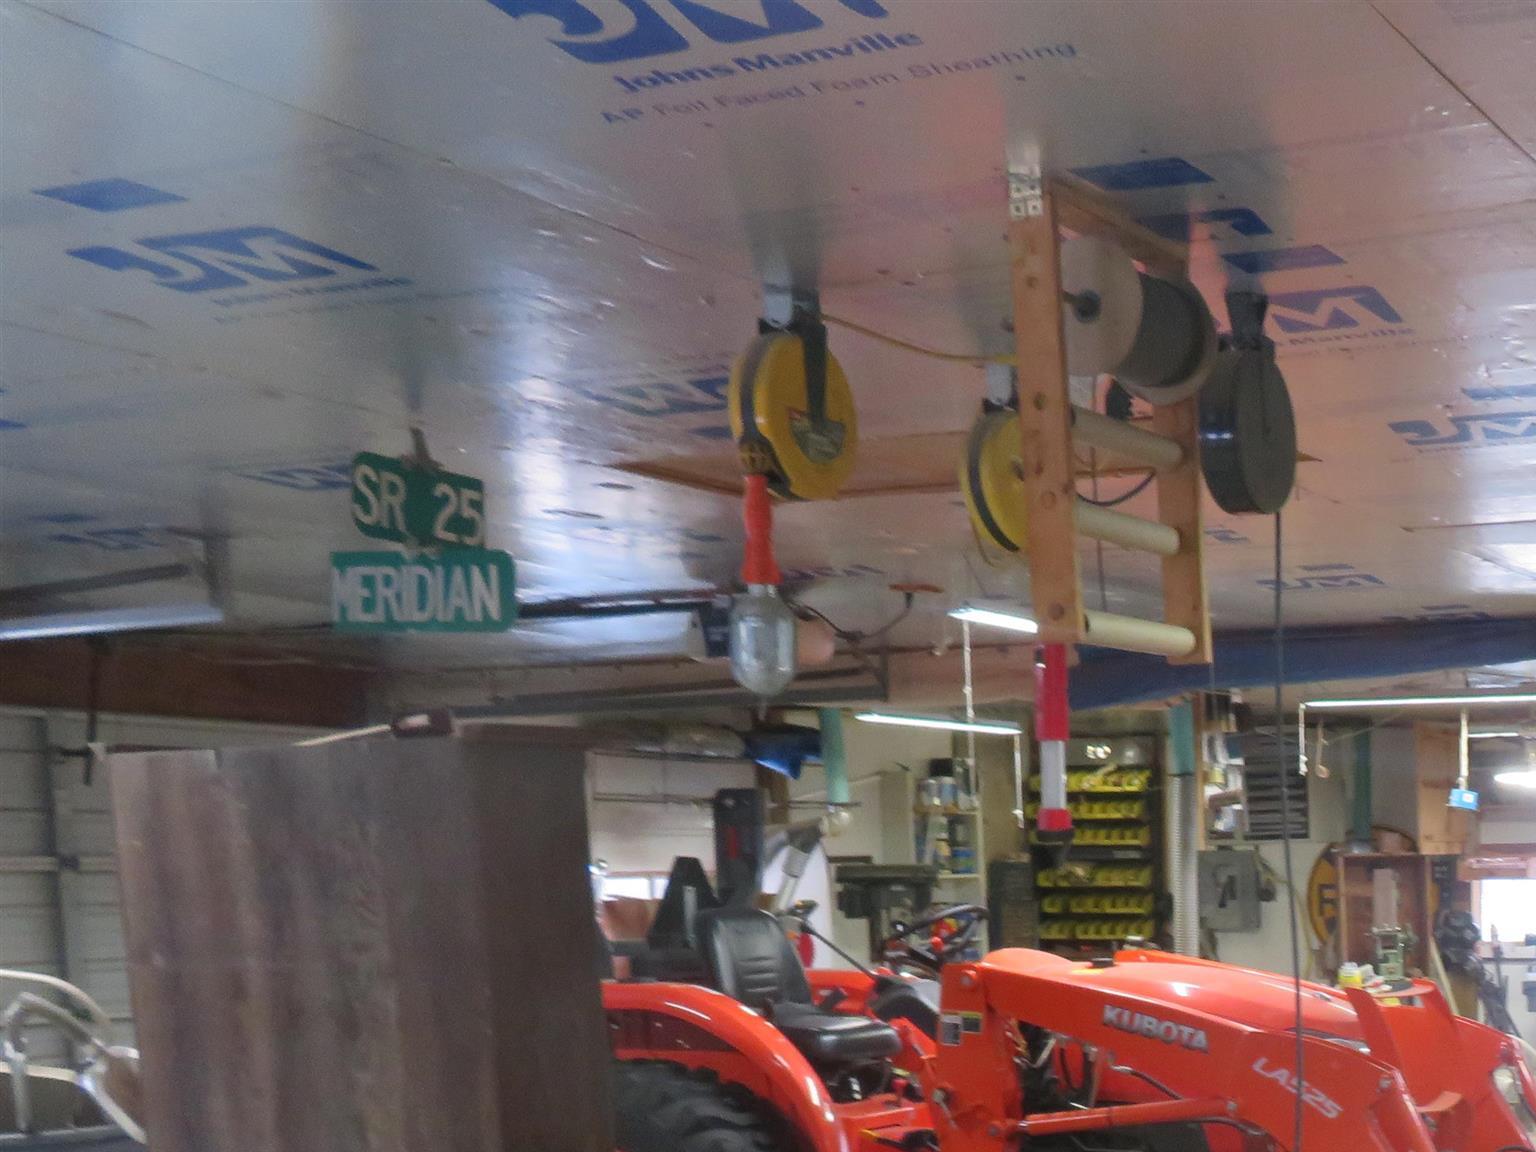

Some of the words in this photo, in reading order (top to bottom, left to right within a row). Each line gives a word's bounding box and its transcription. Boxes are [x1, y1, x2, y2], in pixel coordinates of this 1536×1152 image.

[612, 64, 735, 93] Johns
[731, 32, 924, 73] Manville
[906, 42, 1077, 79] Sheathing
[353, 464, 409, 532] SR
[433, 481, 483, 546] 25
[331, 562, 501, 622] MERIDIAN
[1102, 1004, 1209, 1054] KUBOTA
